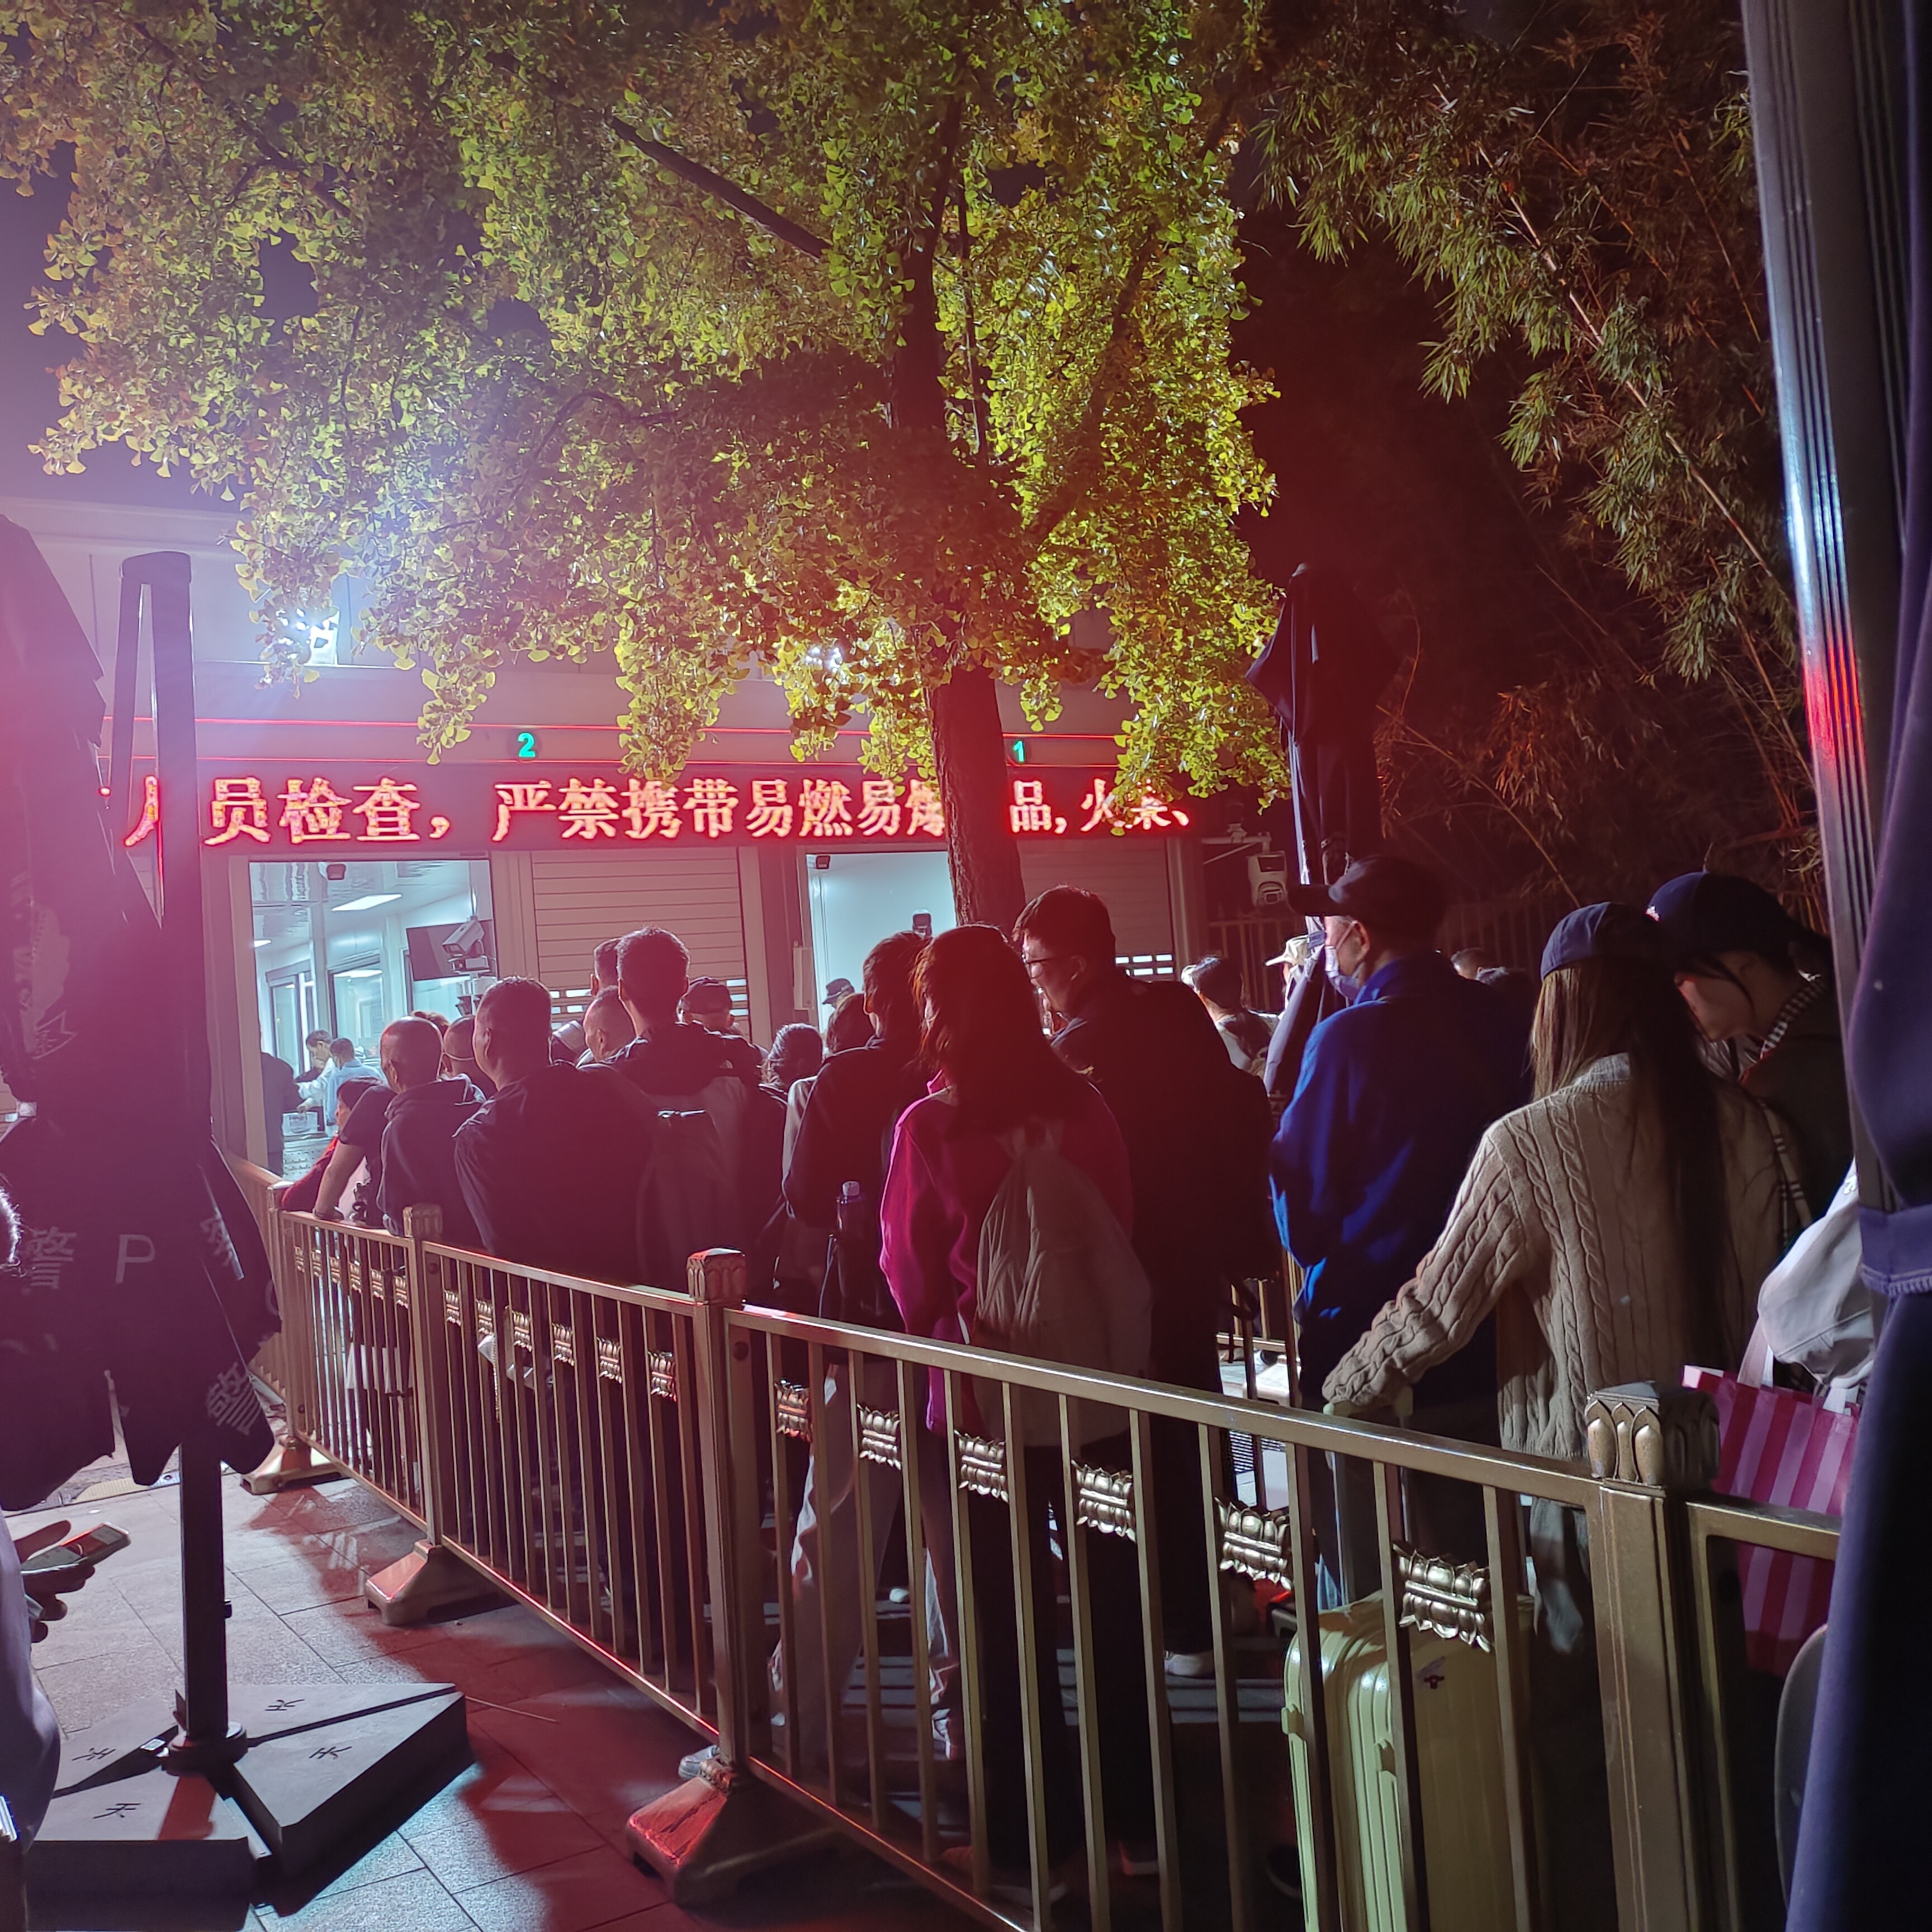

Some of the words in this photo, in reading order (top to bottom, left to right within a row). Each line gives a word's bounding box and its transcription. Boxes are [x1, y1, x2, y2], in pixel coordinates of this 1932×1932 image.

[518, 732, 536, 757] 2
[1012, 740, 1025, 762] 1
[115, 1234, 156, 1284] P
